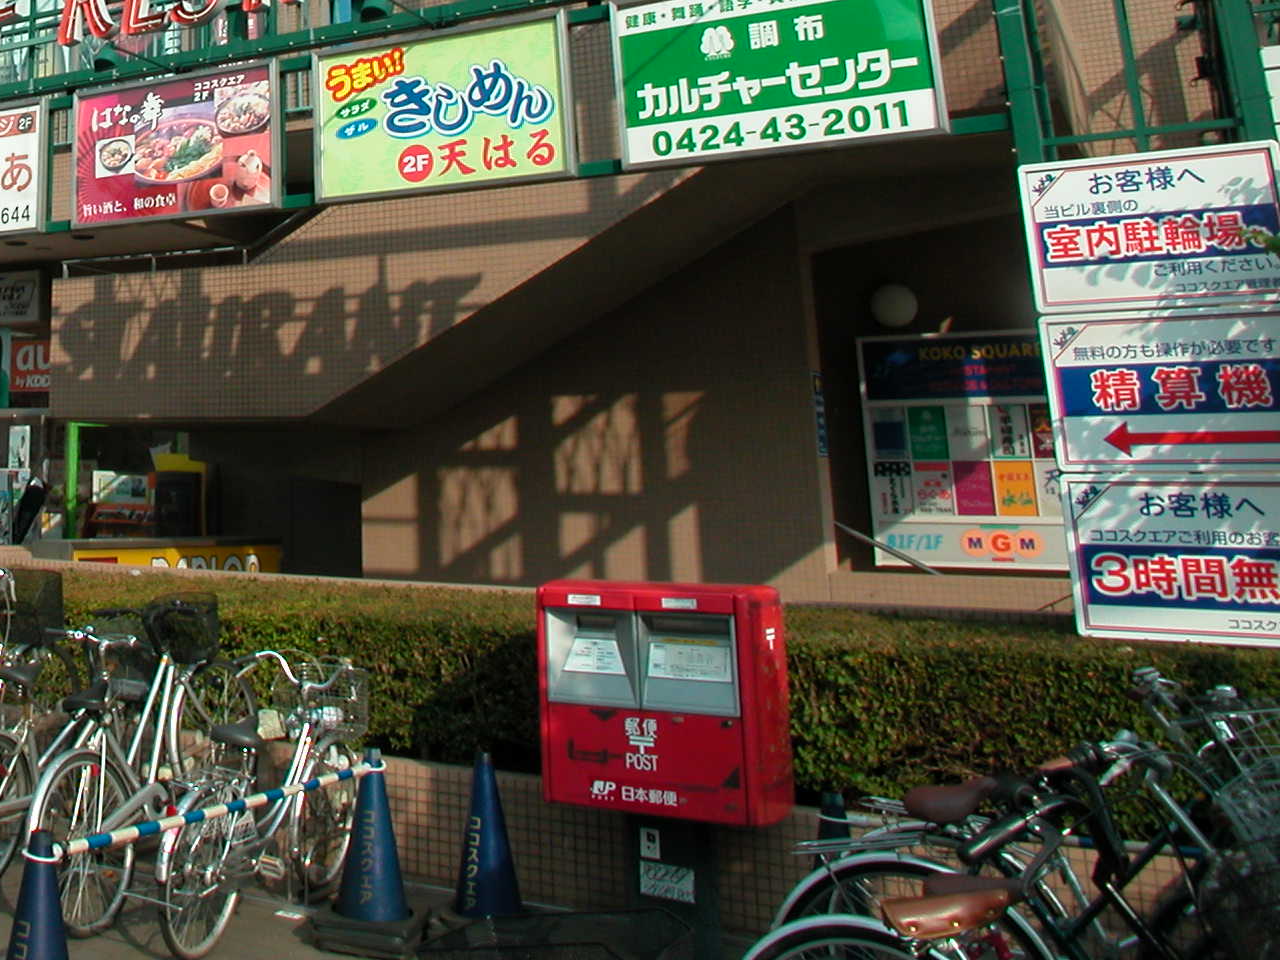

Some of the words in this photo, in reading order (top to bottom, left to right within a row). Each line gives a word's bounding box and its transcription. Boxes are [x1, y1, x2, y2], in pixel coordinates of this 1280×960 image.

[748, 14, 824, 50] 調布
[193, 75, 246, 91] ココスクエア
[328, 49, 404, 101] うまい!
[637, 48, 919, 120] カルチャーセンター
[193, 91, 209, 102] 2F
[340, 99, 370, 118] サラダ
[383, 61, 550, 134] きしめん
[18, 117, 33, 130] 2F
[91, 92, 165, 132] はなの舞
[344, 122, 369, 138] ザル
[652, 100, 911, 157] 0424-43-2011
[402, 153, 430, 174] 2F
[437, 128, 556, 177] 天はる
[1088, 166, 1205, 195] お客様へ
[1044, 199, 1139, 219] 当ビル裏側の
[919, 346, 965, 361] KOKO
[1073, 339, 1275, 361] 無料の方も操作が必要です
[1091, 363, 1273, 411] 精算機
[1138, 492, 1265, 520] お客様へ
[1092, 552, 1280, 604] 3時間無
[624, 718, 658, 738] 郵便
[625, 753, 659, 772] POST
[621, 786, 678, 807] 日本郵便
[359, 809, 375, 905] ココスクエア
[465, 816, 481, 910] ココスクエア
